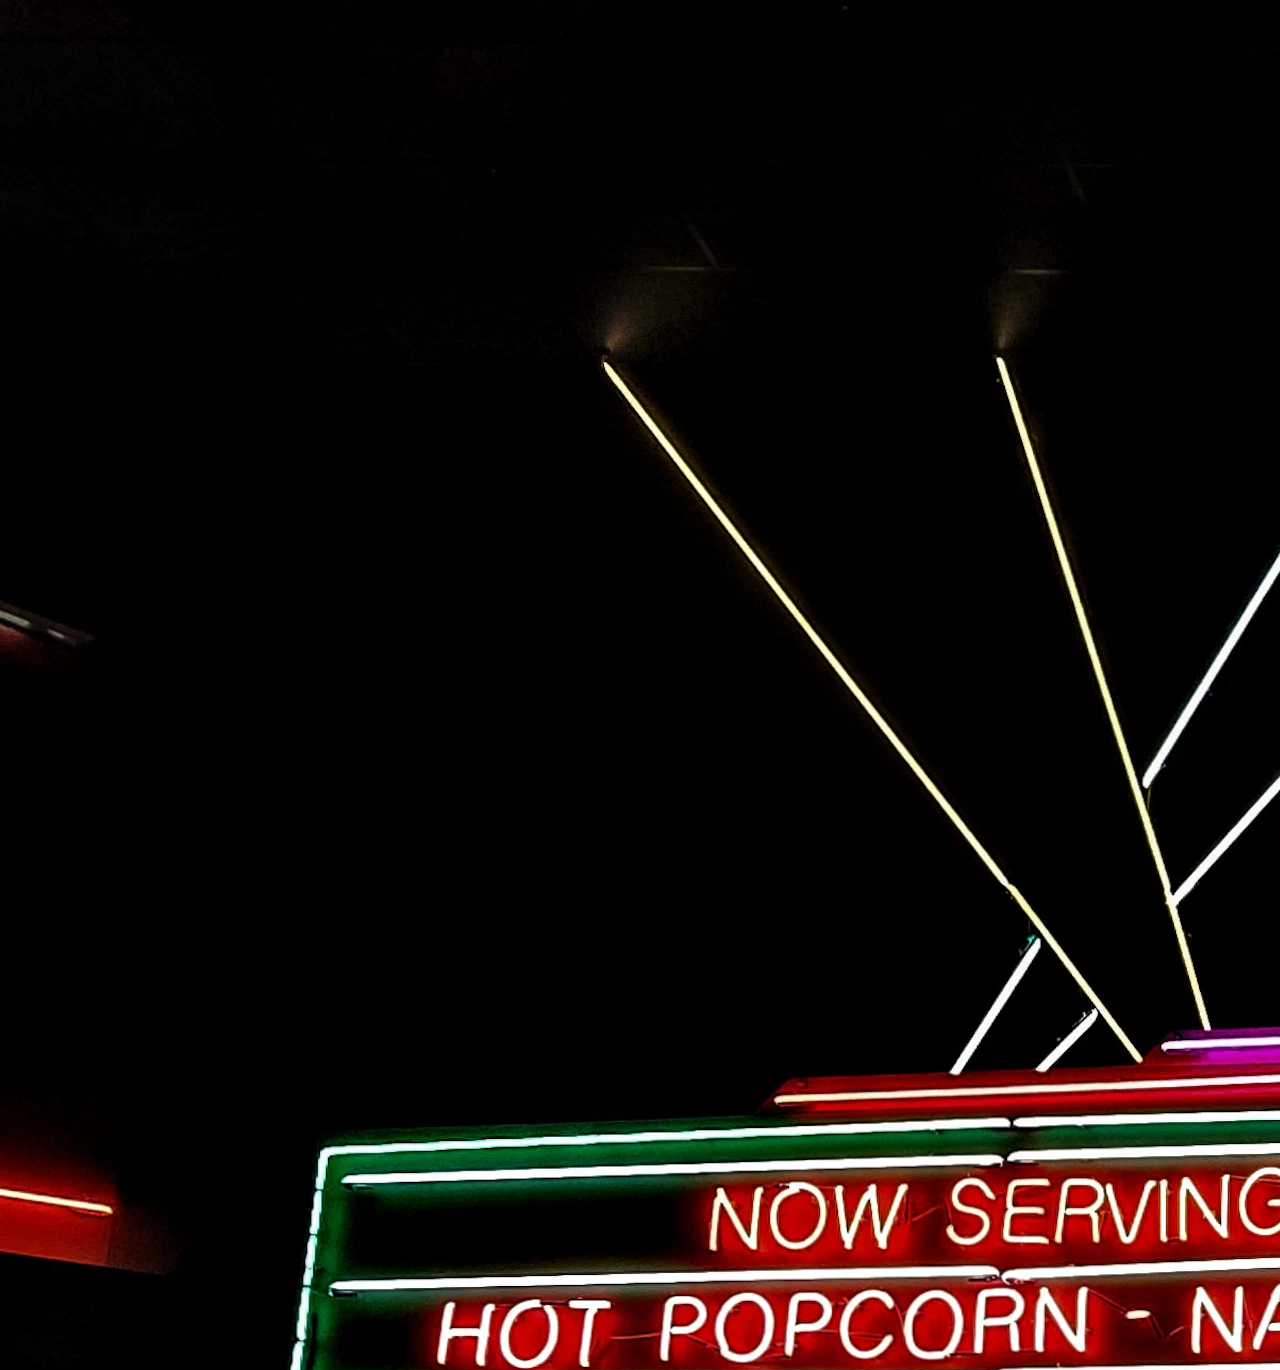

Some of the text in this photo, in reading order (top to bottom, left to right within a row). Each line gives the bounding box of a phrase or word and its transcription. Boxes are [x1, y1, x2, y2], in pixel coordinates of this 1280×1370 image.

[707, 1181, 911, 1253] NOW
[435, 1298, 613, 1369] HOT
[658, 1286, 1090, 1363] POPCORN
